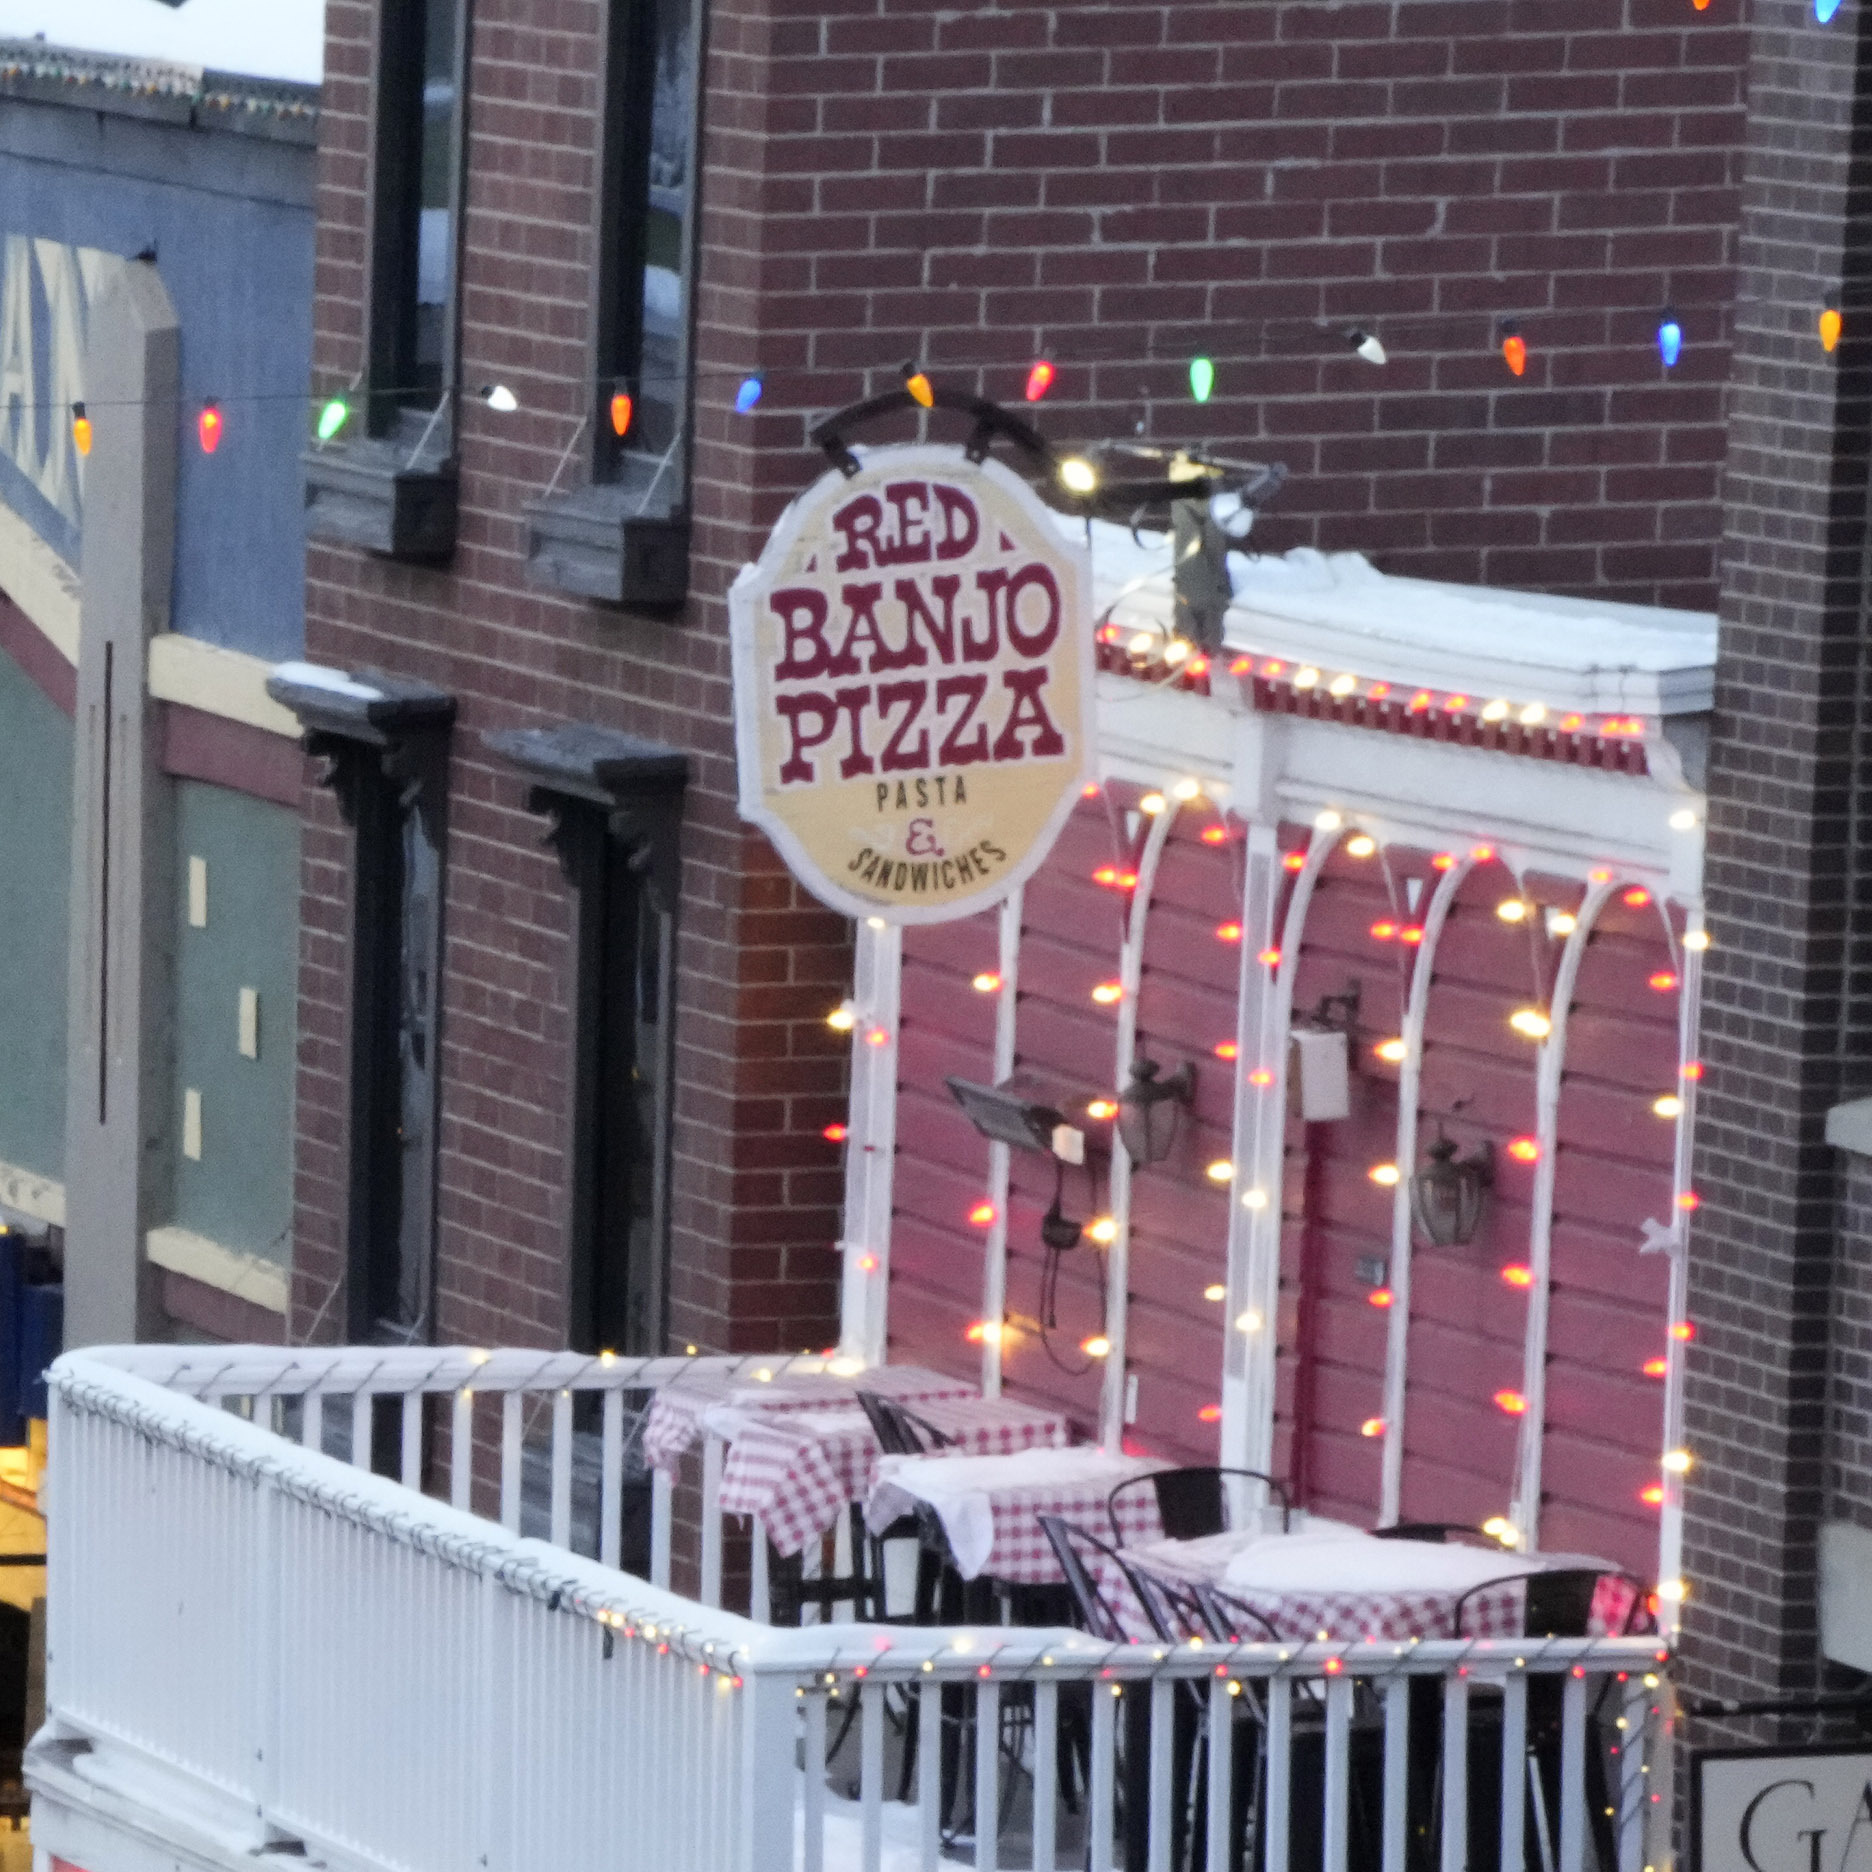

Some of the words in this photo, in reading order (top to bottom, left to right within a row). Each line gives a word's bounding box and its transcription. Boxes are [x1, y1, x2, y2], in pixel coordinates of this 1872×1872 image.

[833, 480, 979, 573] RED
[770, 562, 1062, 681] BANJO
[774, 665, 1064, 785] PIZZA
[876, 775, 968, 812] PASTA
[848, 840, 1008, 892] SANDWICHES
[905, 818, 944, 857] &
